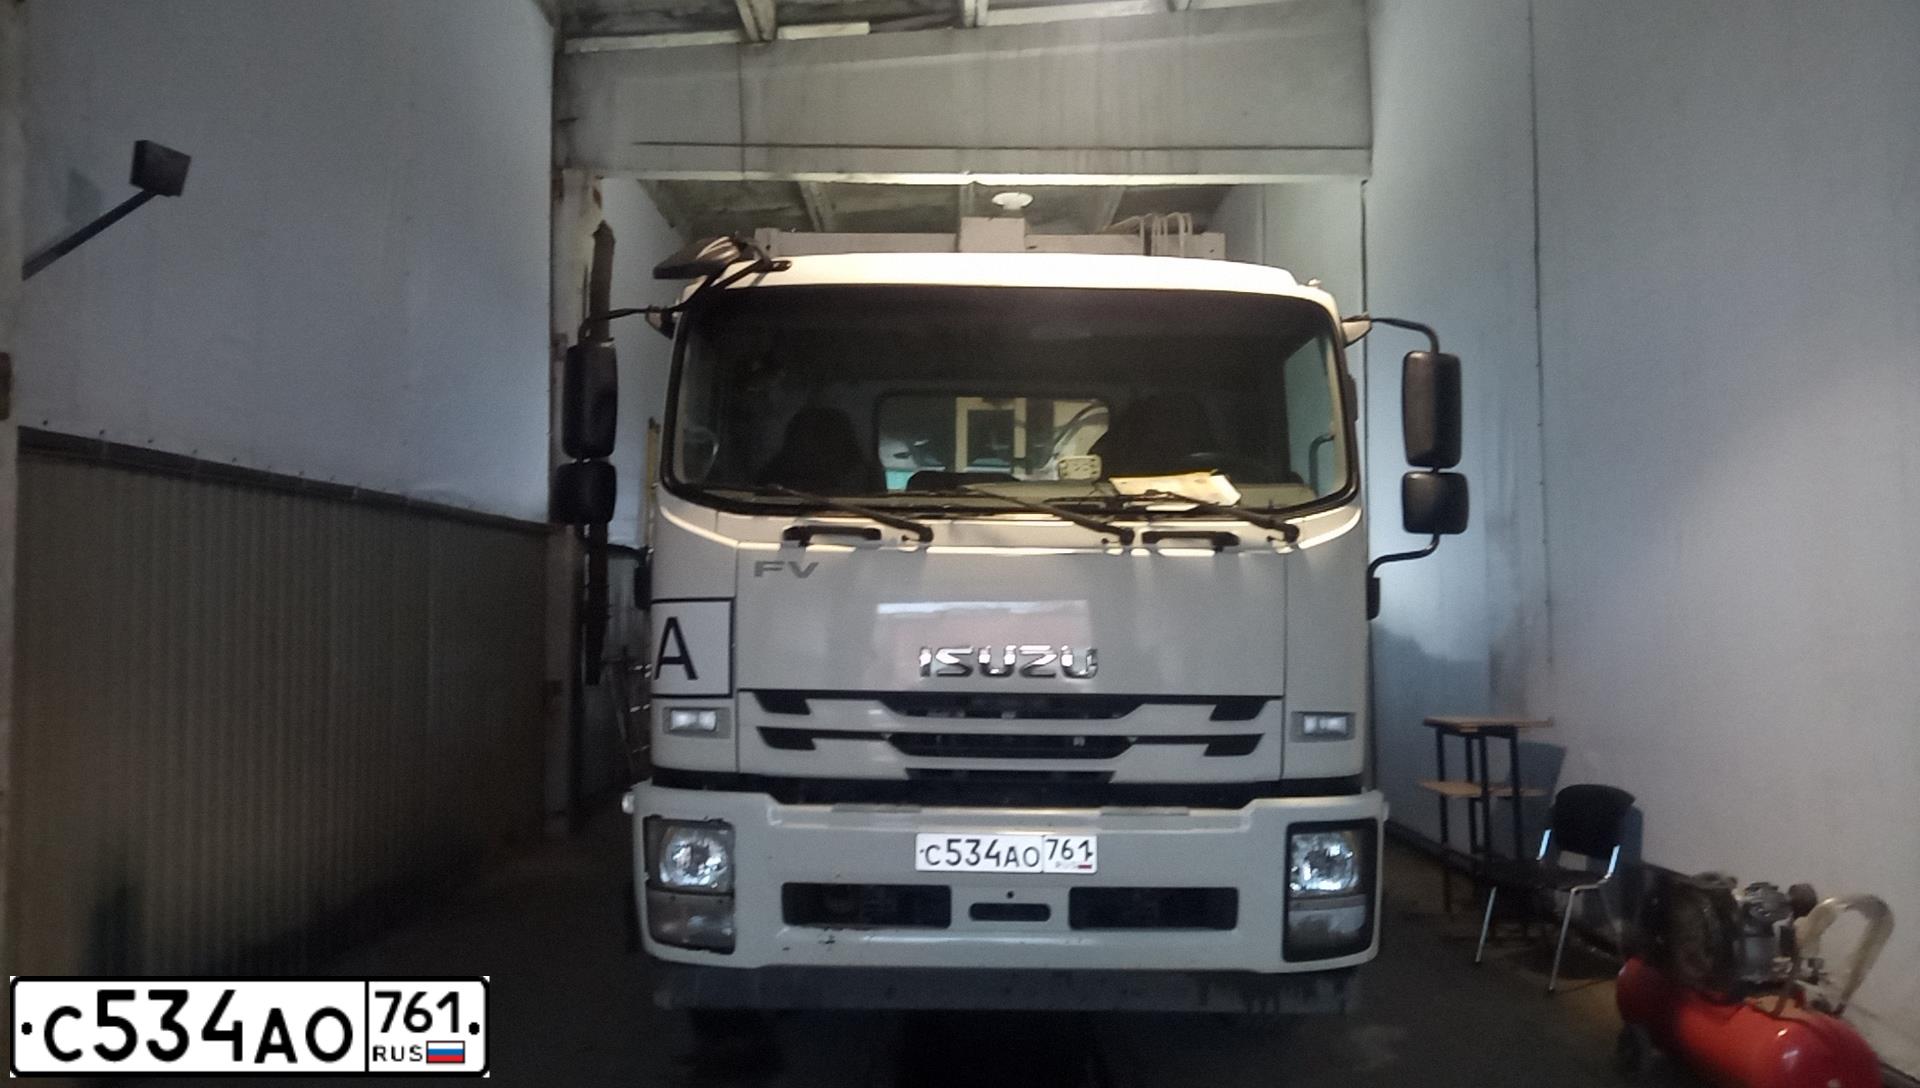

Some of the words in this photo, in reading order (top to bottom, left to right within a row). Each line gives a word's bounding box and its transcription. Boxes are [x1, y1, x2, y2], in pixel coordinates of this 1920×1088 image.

[754, 561, 819, 578] FV
[653, 617, 698, 680] A
[918, 644, 1098, 679] ISUZU
[1048, 839, 1091, 861] 761
